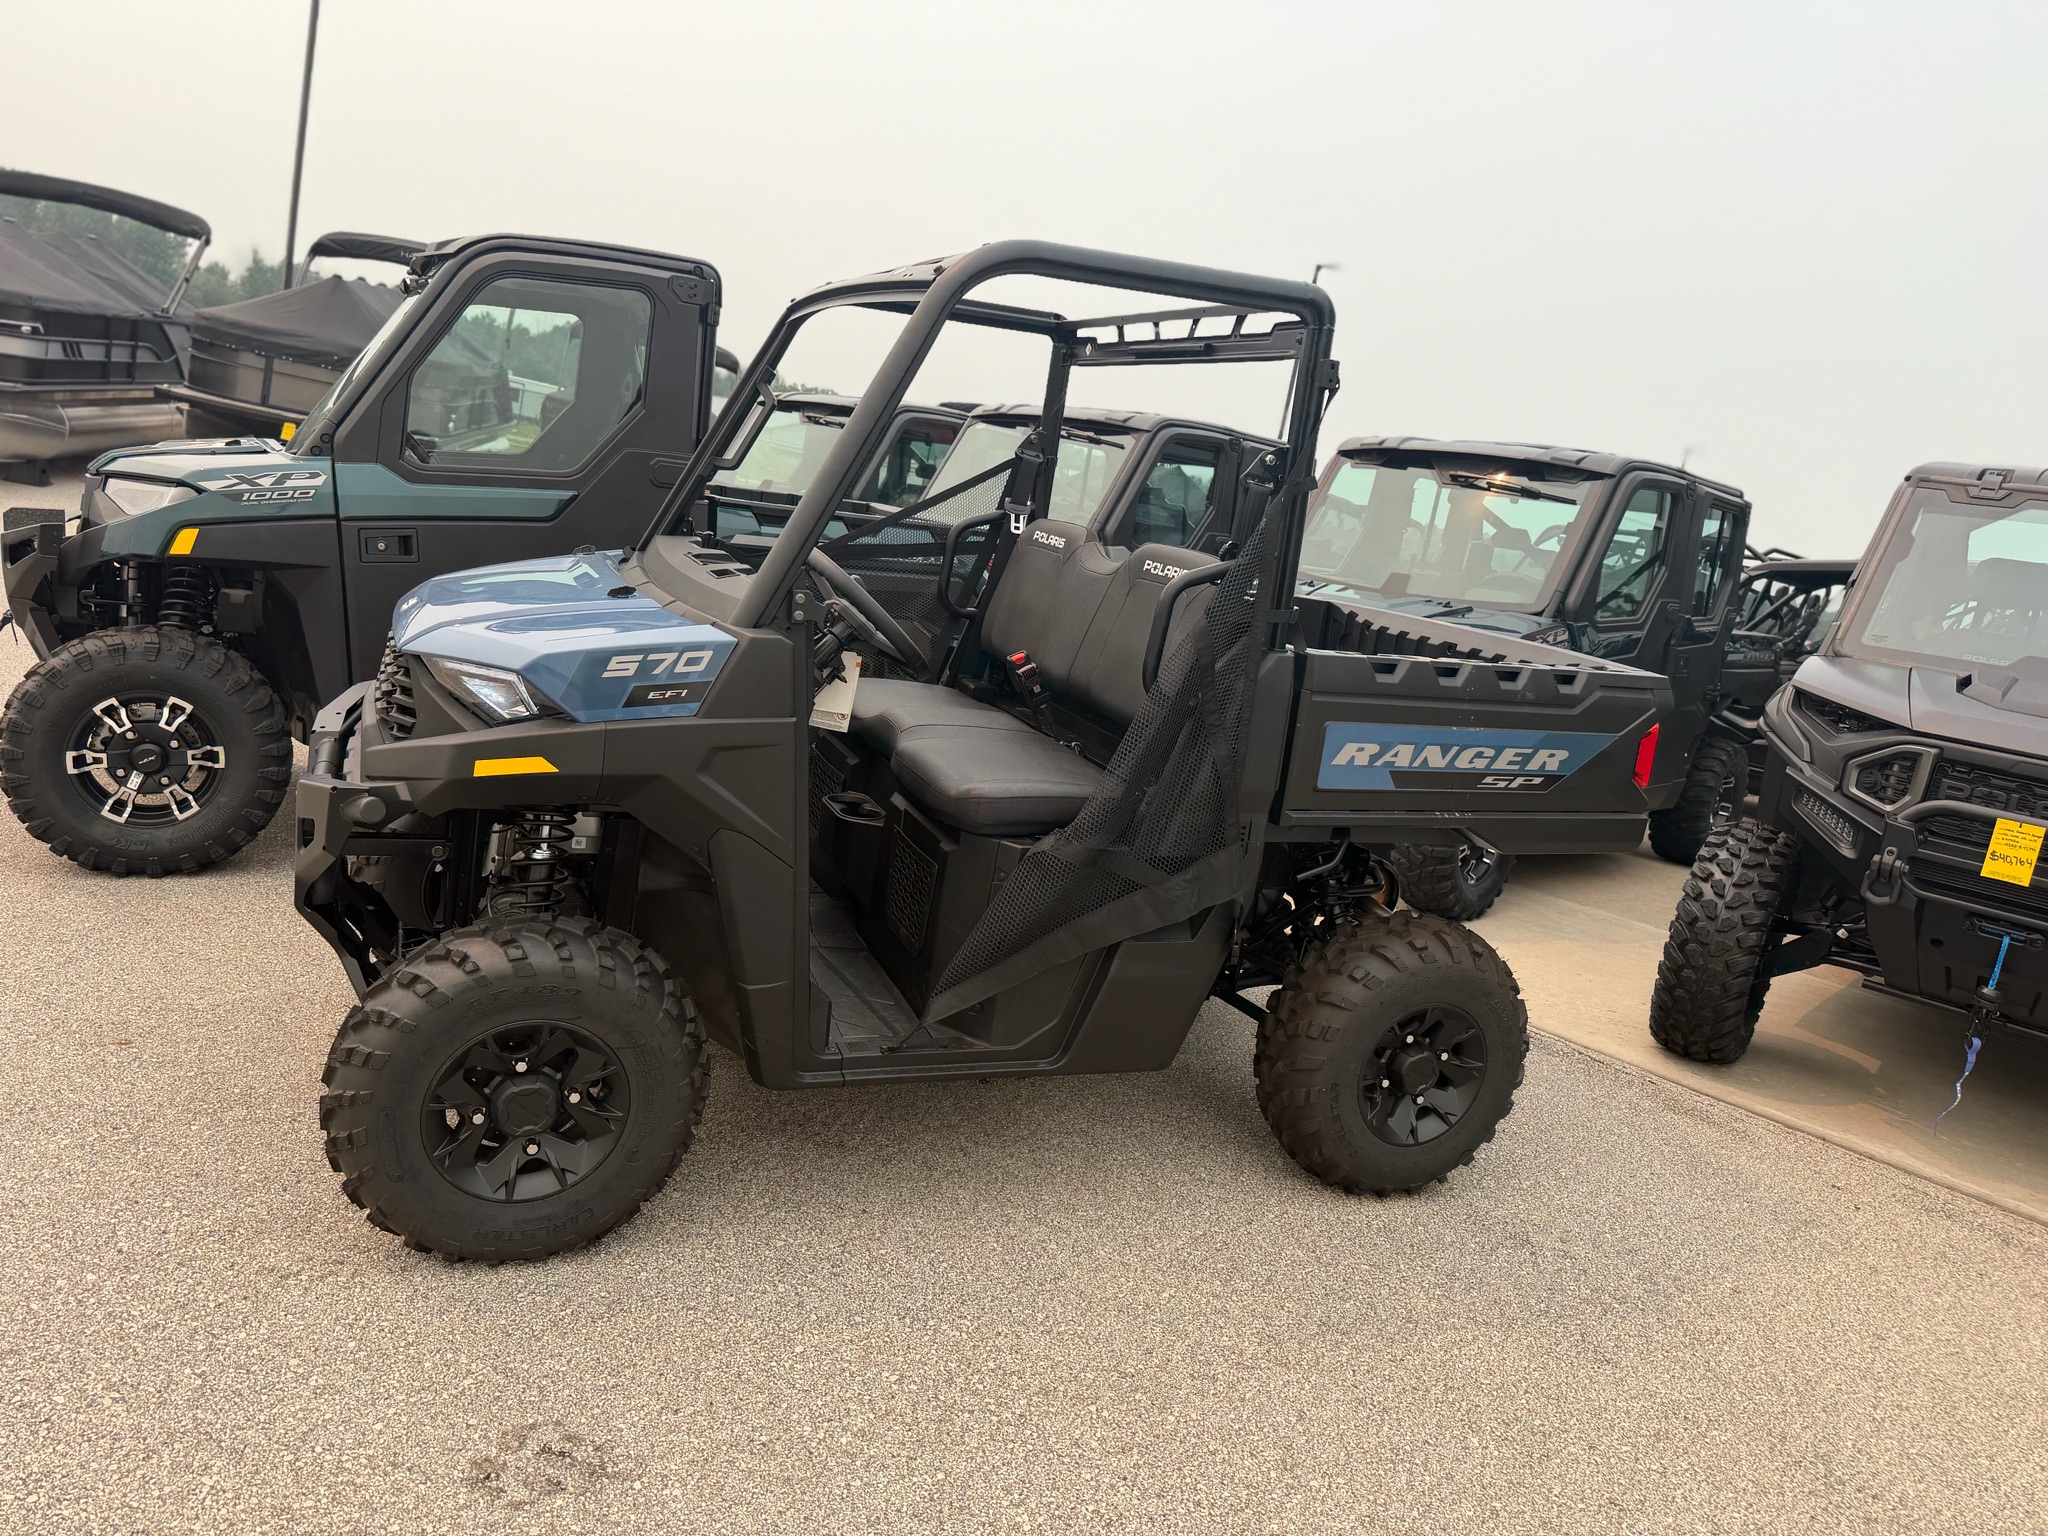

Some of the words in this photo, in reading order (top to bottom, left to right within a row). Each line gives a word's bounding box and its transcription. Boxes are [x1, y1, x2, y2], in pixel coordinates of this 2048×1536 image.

[216, 470, 325, 491] XP
[242, 489, 316, 500] 1000
[1032, 530, 1066, 549] POLARIS
[1535, 627, 1569, 645] XP
[601, 650, 714, 678] 570
[647, 689, 689, 699] EFI
[1331, 742, 1570, 771] RANGER
[1476, 775, 1545, 788] SP
[1989, 850, 2033, 868] $40,764
[464, 983, 582, 1016] AT489
